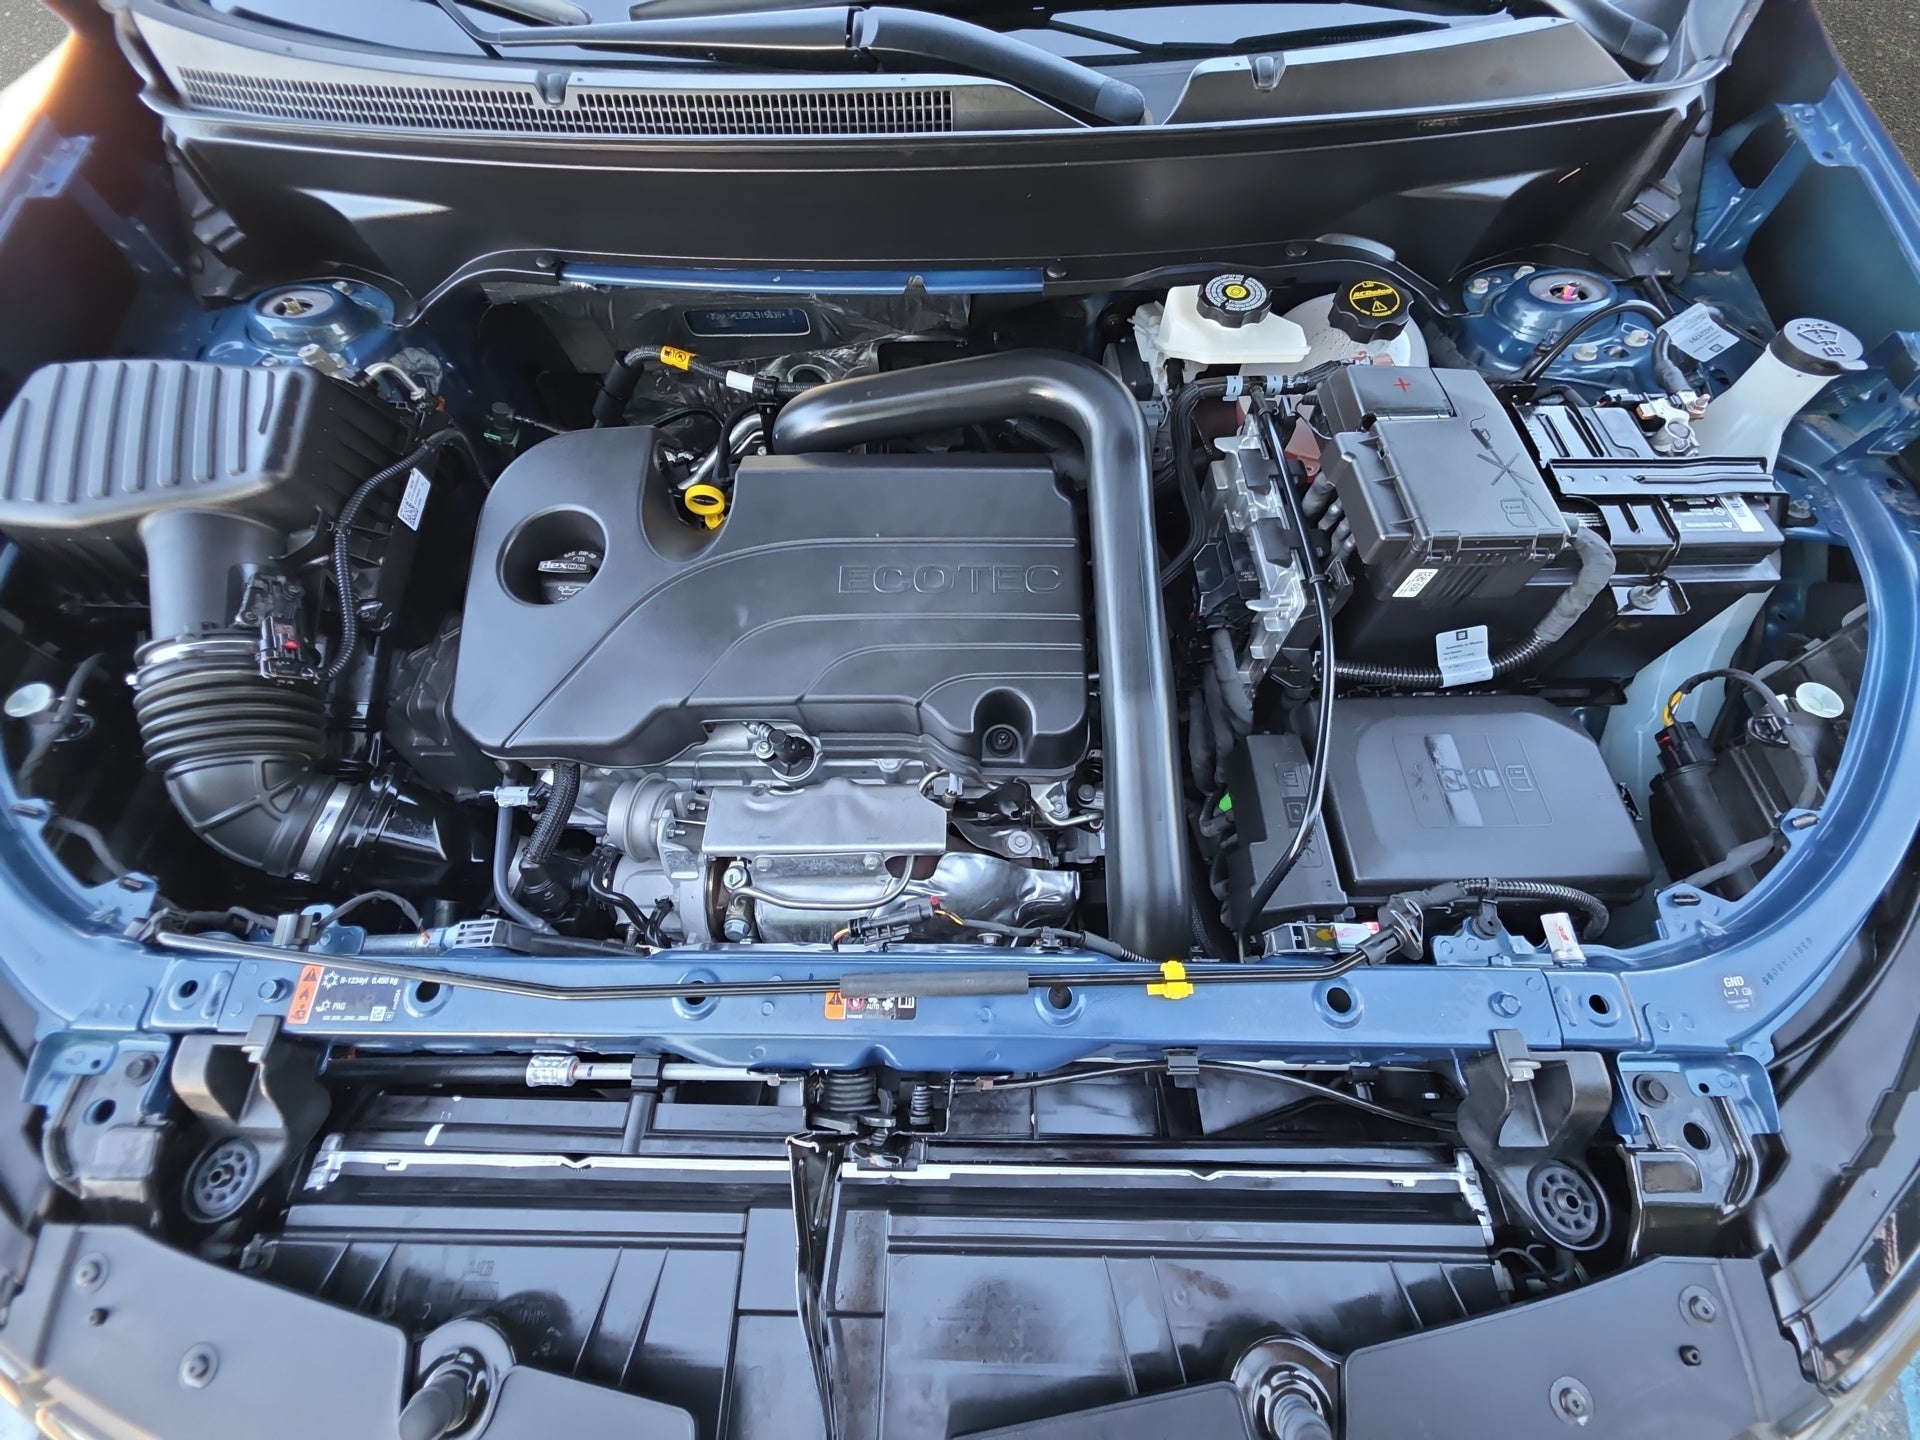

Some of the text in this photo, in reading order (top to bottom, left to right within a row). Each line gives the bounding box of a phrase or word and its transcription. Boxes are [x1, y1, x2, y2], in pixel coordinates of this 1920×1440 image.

[838, 564, 1062, 593] ECOTEC
[340, 976, 369, 985] R-1234yf
[1723, 976, 1744, 987] GND
[332, 1002, 346, 1010] PAG
